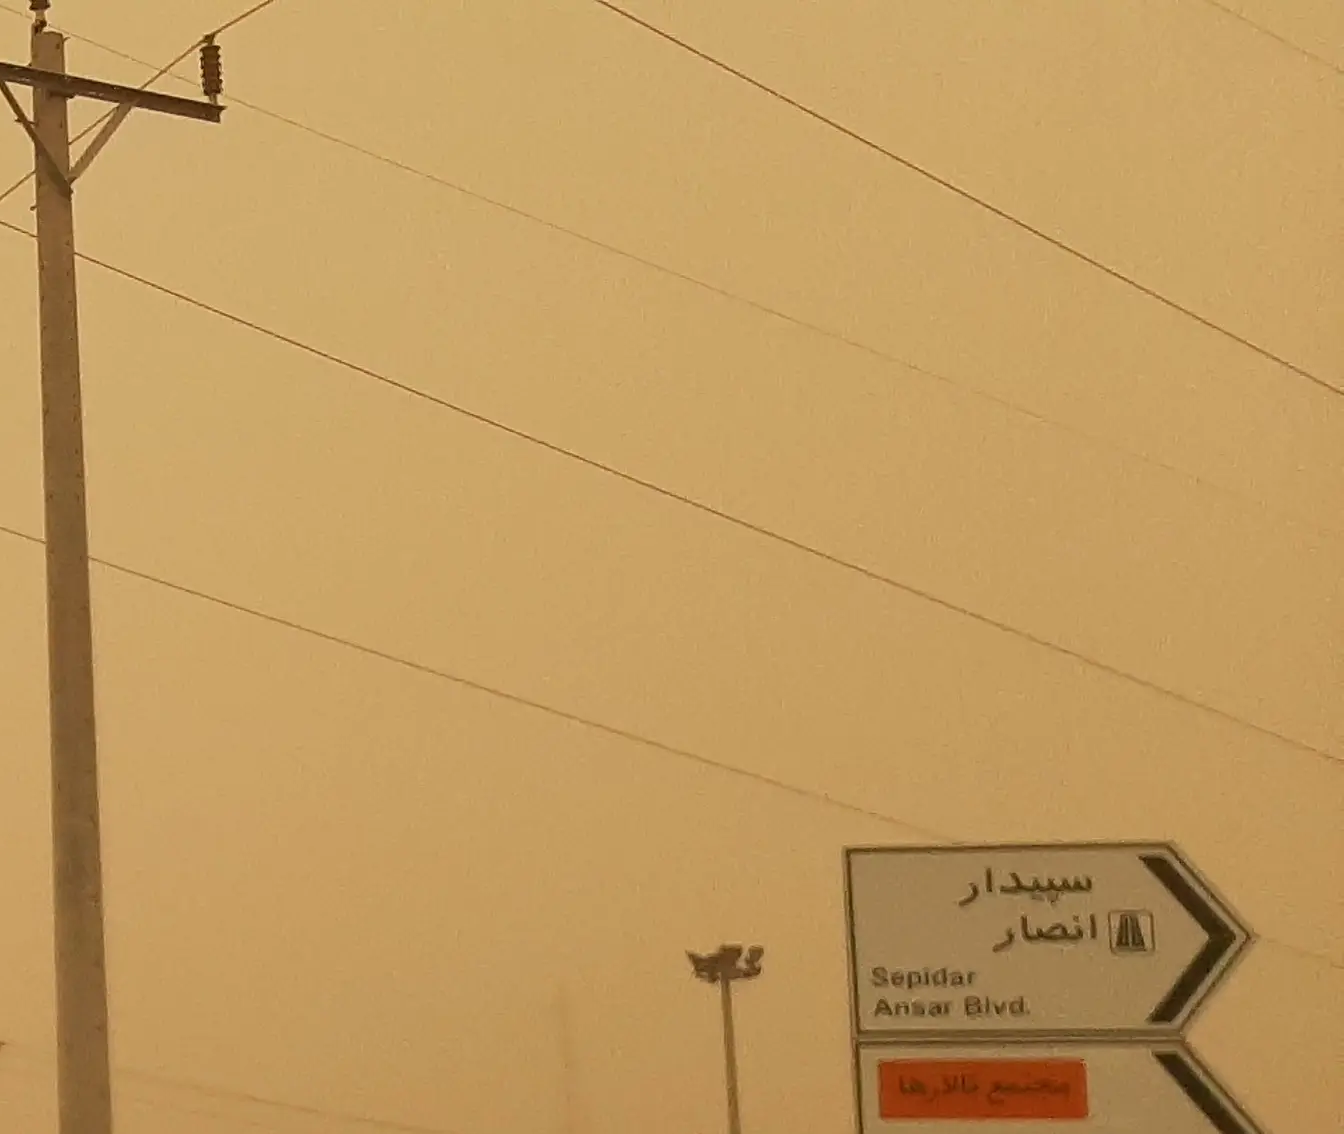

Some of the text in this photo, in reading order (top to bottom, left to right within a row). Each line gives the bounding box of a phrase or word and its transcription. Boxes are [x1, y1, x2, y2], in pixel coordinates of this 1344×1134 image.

[958, 867, 1093, 906] سپیدار
[991, 912, 1097, 953] انصار
[871, 966, 976, 990] Sepidar
[874, 996, 1030, 1017] Ansar Blvd.
[988, 1070, 1071, 1106] مجتمع
